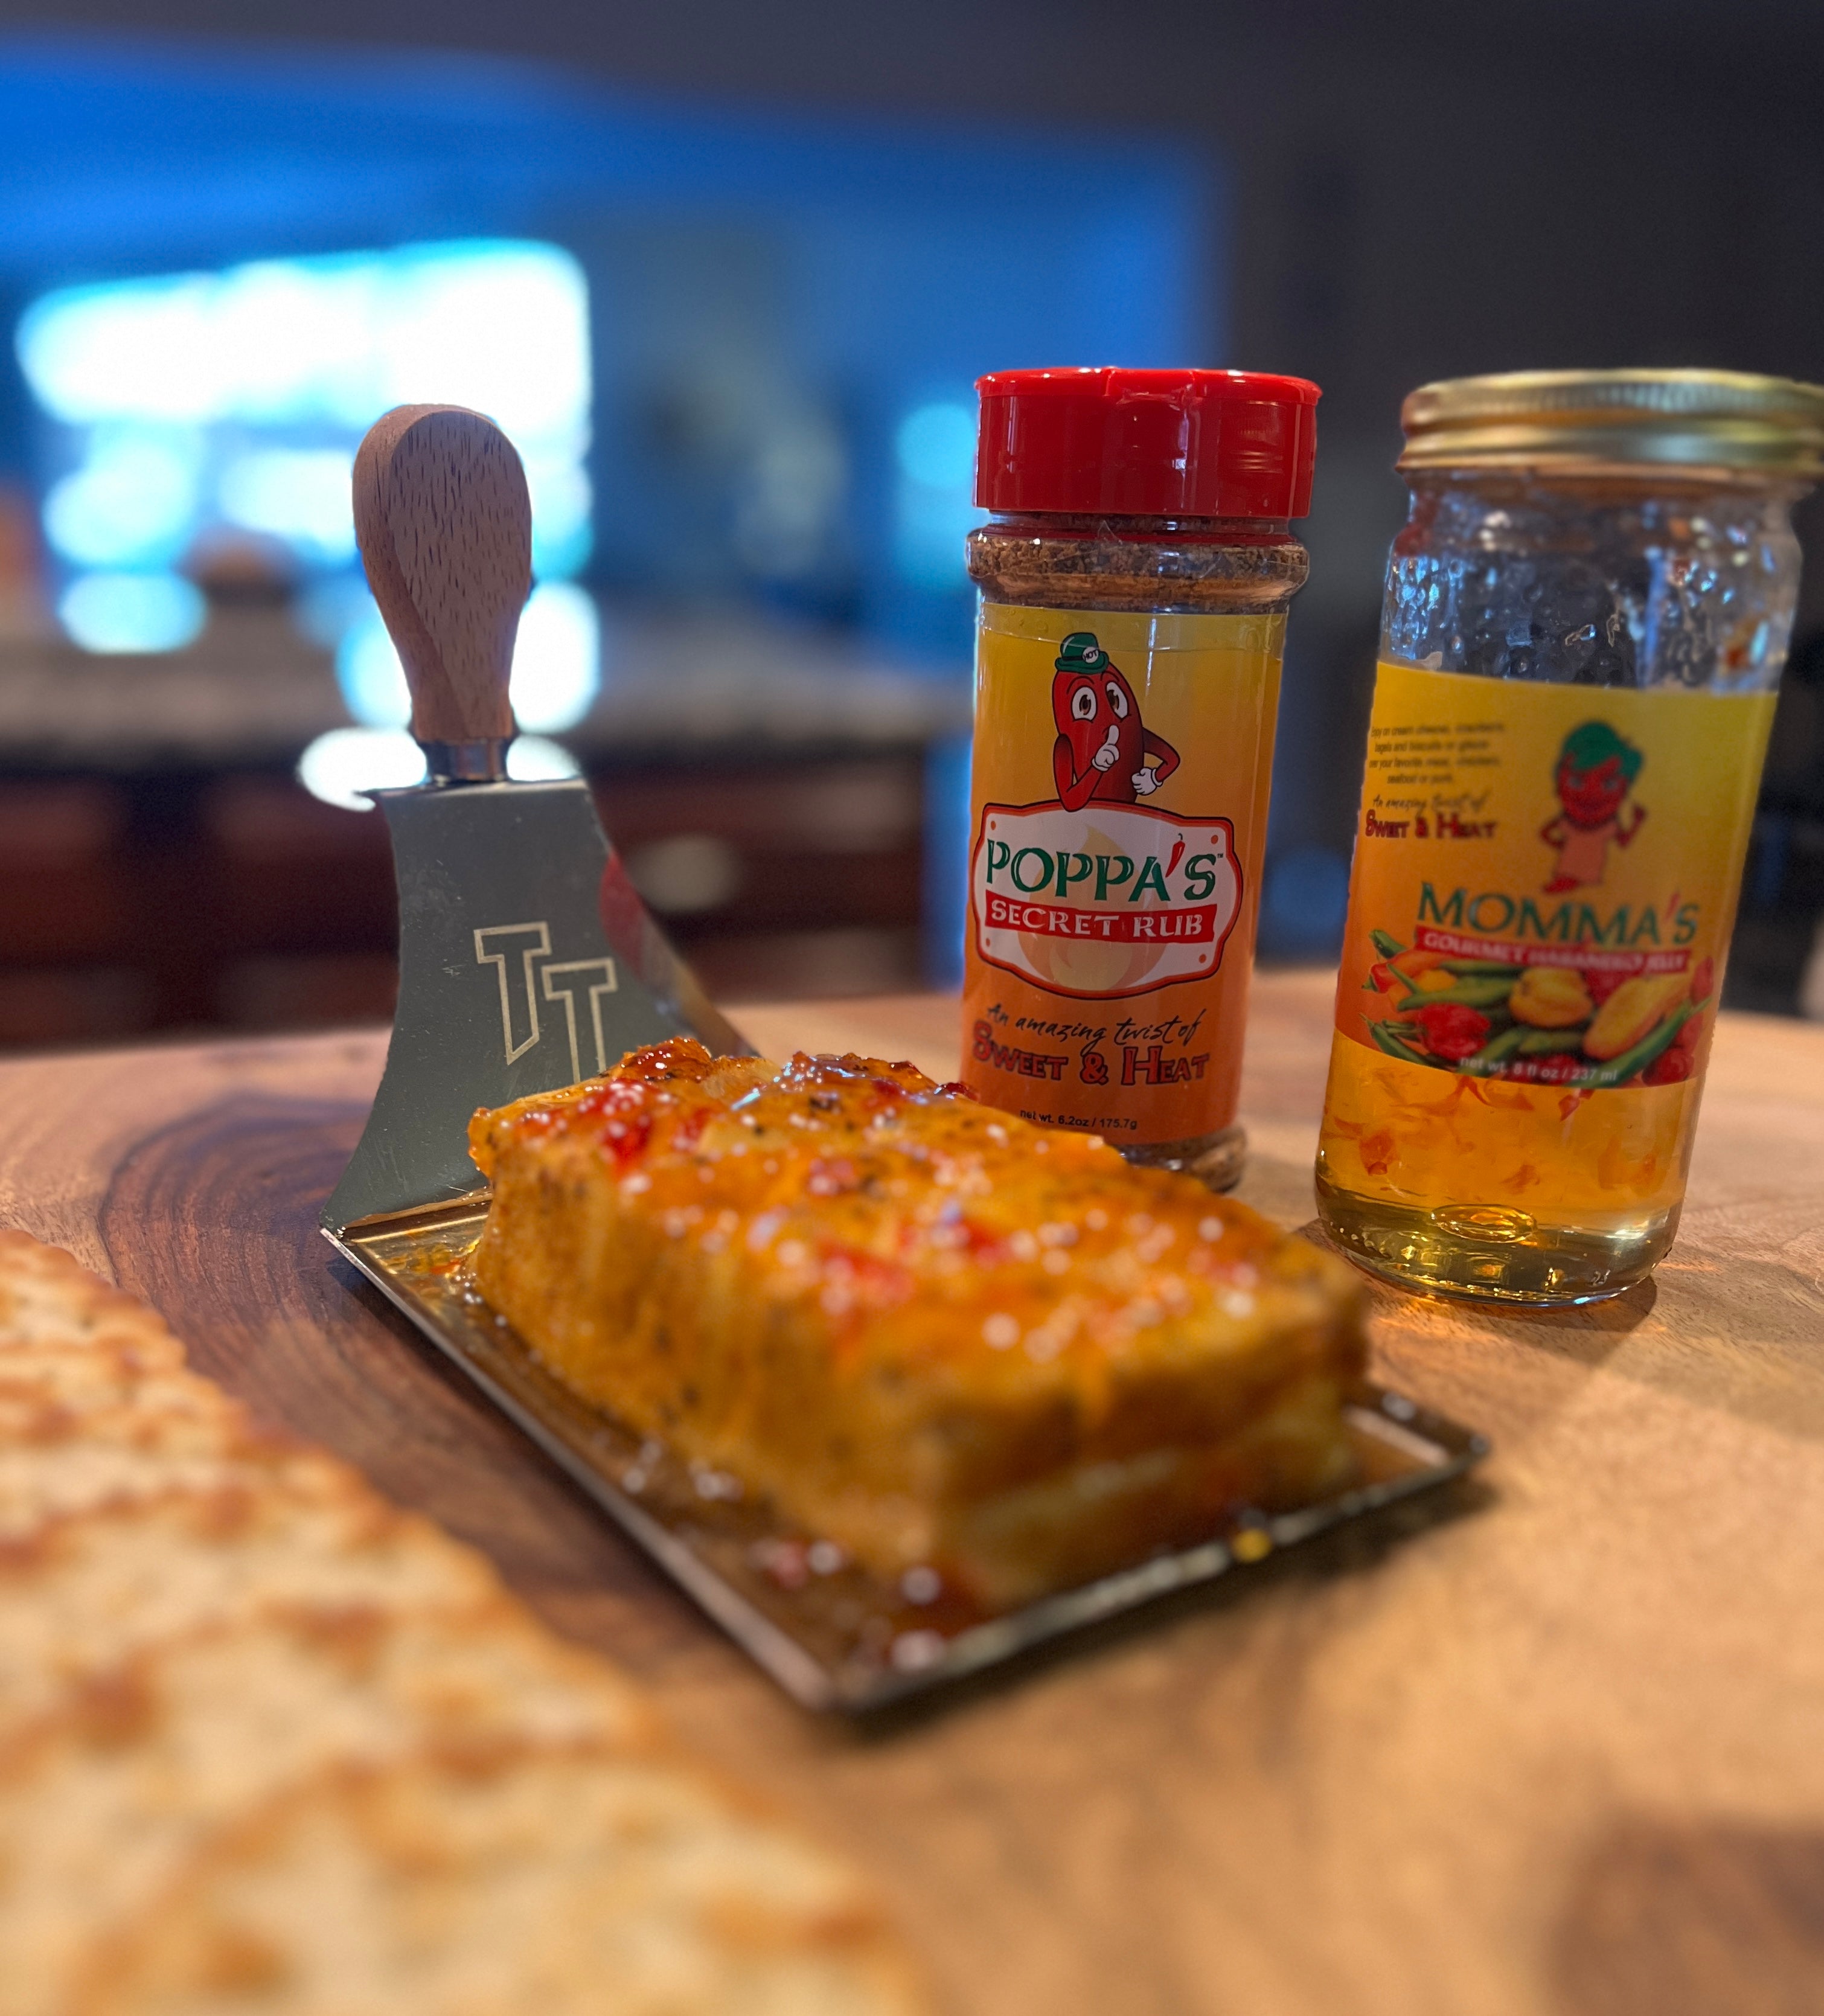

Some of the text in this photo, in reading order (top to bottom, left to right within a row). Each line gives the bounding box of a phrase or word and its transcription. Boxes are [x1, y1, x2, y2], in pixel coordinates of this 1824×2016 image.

[1083, 649, 1098, 662] HOT
[987, 833, 1217, 902] POPPA'S
[991, 900, 1203, 938] SECRET RUB
[1417, 880, 1699, 946] MOMMA'S
[972, 1020, 1211, 1086] SWEET & HEAT
[987, 1003, 1207, 1057] An amazing twist of
[1461, 1055, 1484, 1069] net
[1487, 1061, 1508, 1074] wt.
[1513, 1063, 1522, 1076] 8
[1541, 1067, 1558, 1079] oz
[1571, 1067, 1597, 1082] 237
[1601, 1068, 1618, 1081] ml
[1020, 1110, 1037, 1121] net
[1039, 1113, 1055, 1124] wt.
[1058, 1115, 1089, 1127] 6.2oz
[1099, 1118, 1138, 1130] 175.7g
